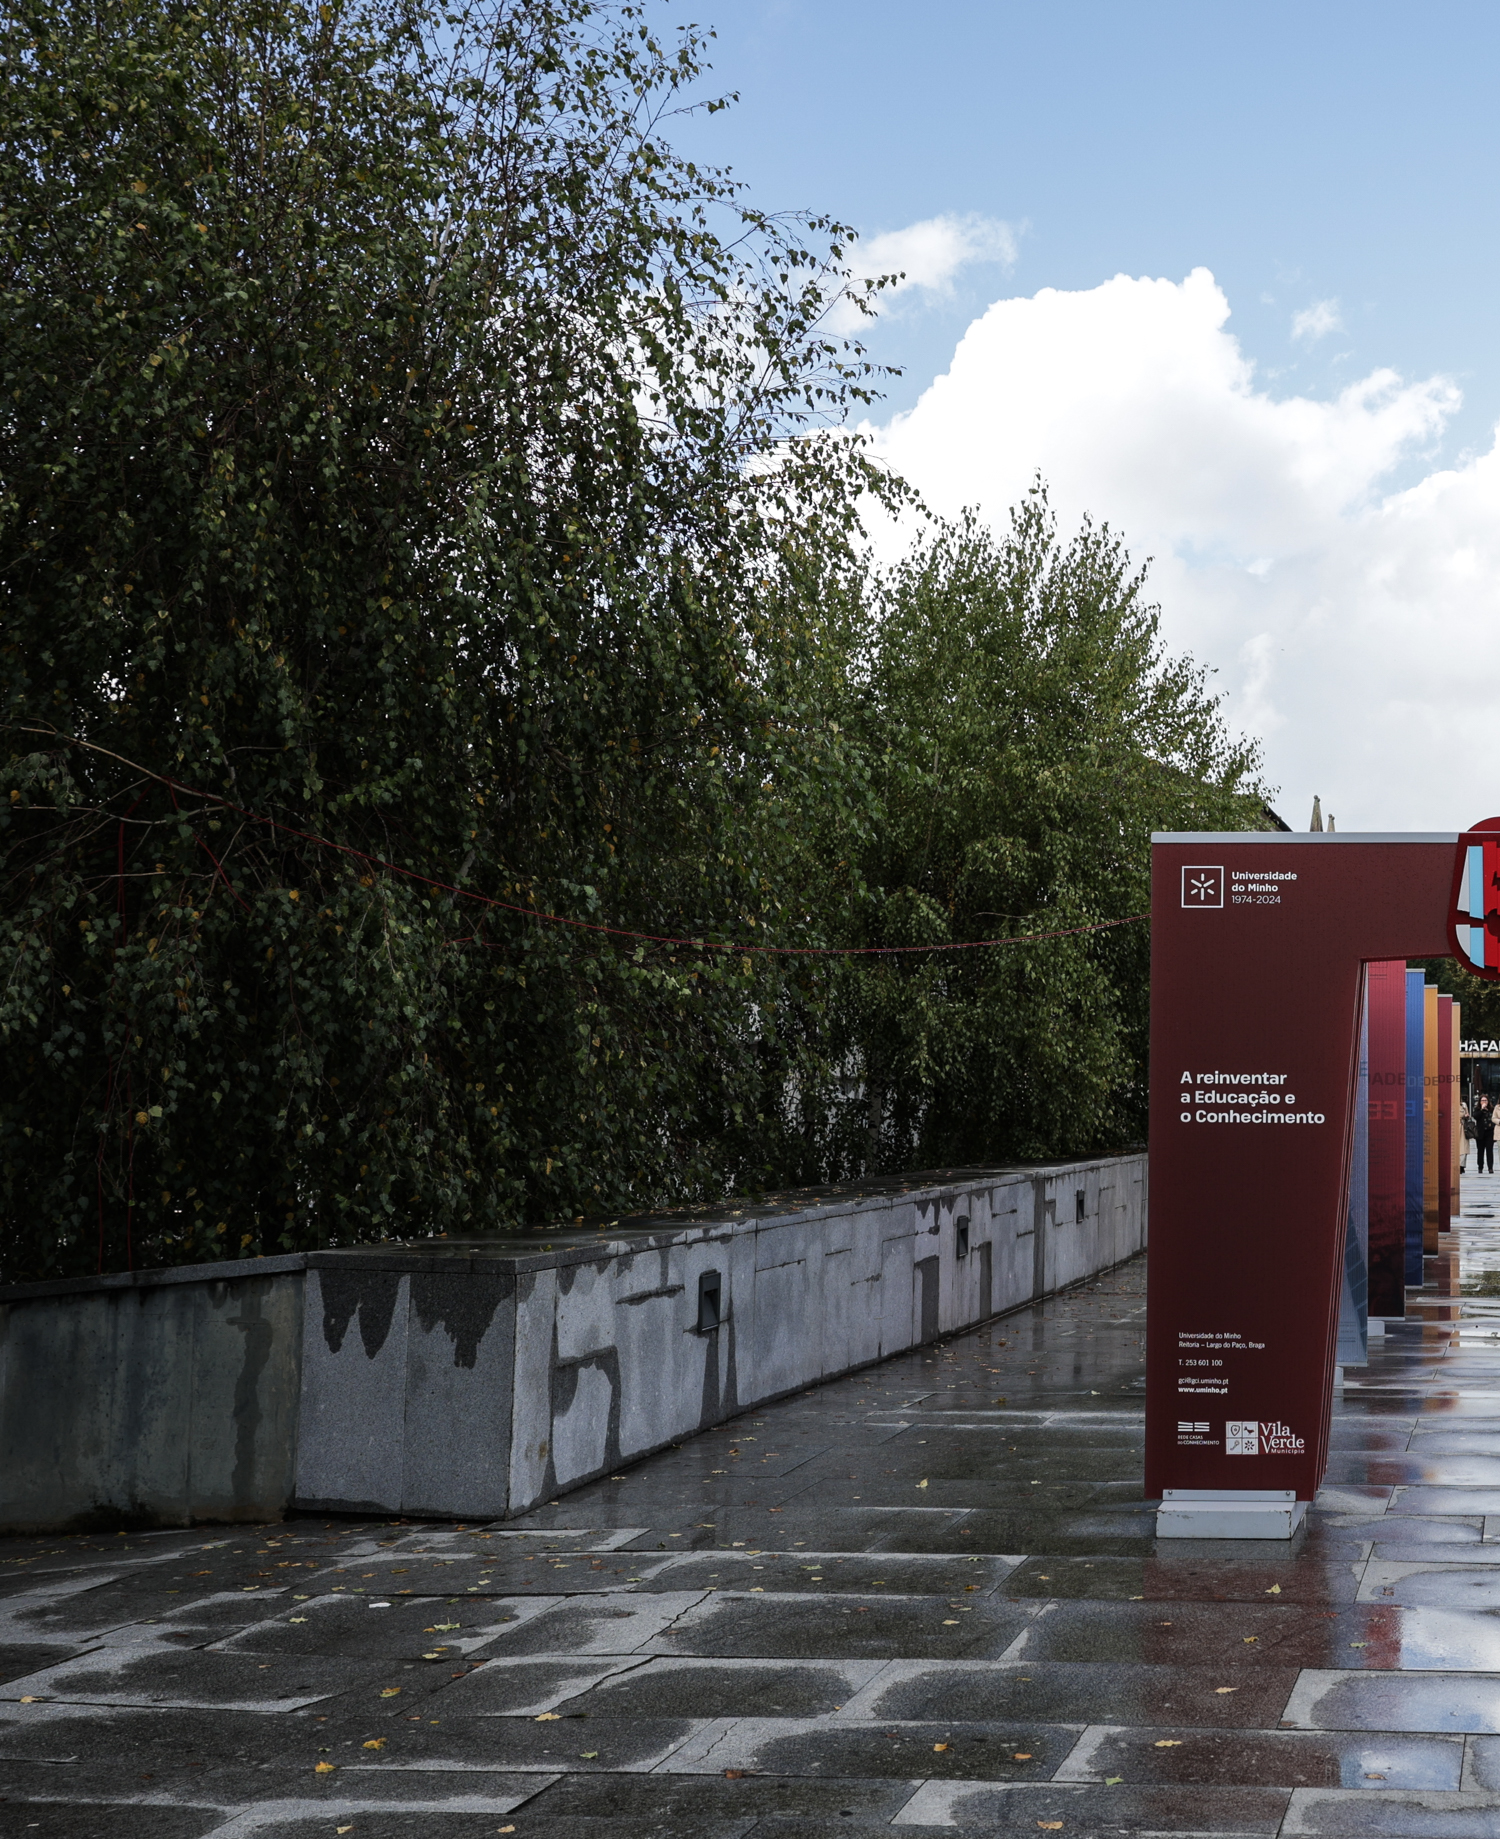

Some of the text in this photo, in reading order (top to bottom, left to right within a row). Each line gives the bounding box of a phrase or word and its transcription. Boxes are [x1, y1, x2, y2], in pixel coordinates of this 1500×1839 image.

[1232, 872, 1297, 880] Universidade
[1232, 883, 1245, 891] do
[1232, 895, 1280, 904] 1974-2024
[1180, 1071, 1287, 1084] A reinventar
[1181, 1090, 1295, 1107] a Educação e
[1181, 1110, 1325, 1124] o Conhecimento
[1260, 1421, 1291, 1436] Vila
[1260, 1434, 1304, 1454] Verde
